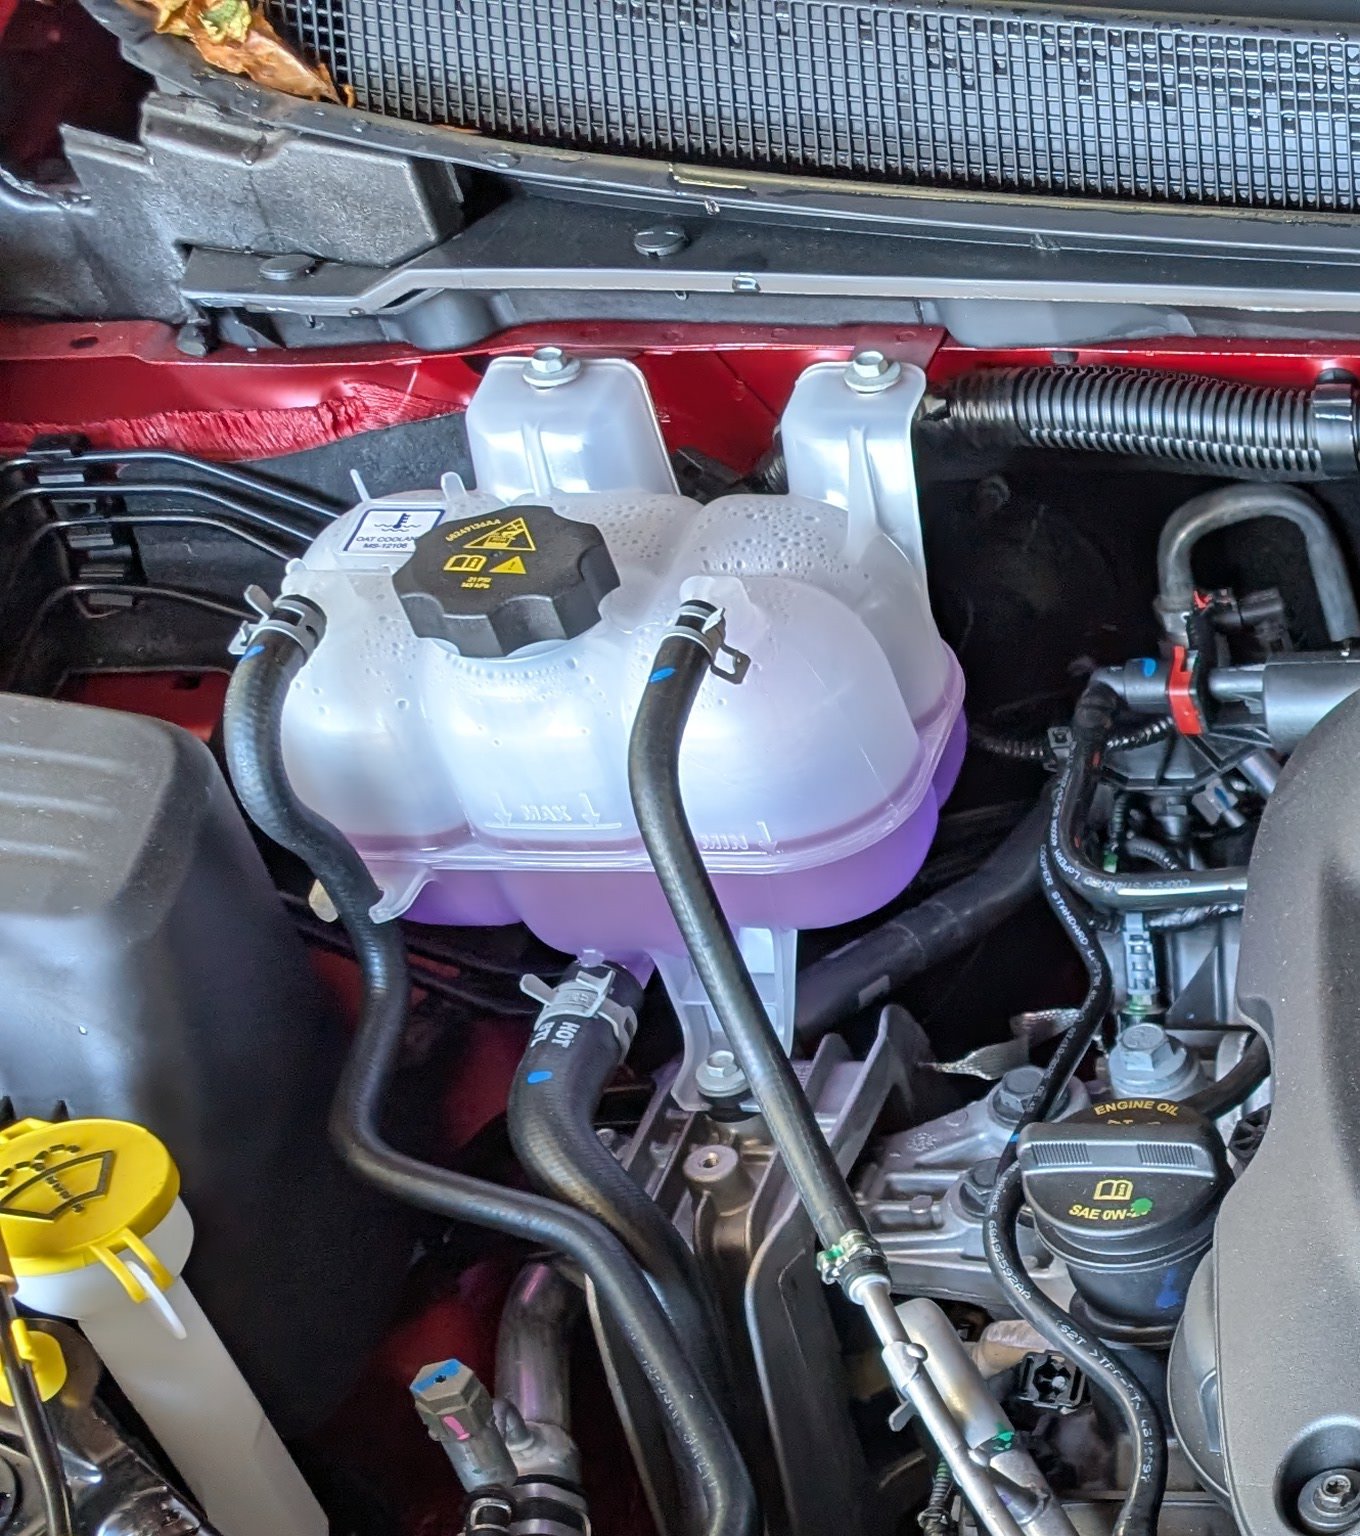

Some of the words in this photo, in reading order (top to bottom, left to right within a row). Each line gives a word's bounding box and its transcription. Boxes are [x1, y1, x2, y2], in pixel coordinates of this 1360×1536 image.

[1039, 844, 1053, 886] COOPER
[1051, 890, 1089, 946] STANDARD
[551, 1021, 581, 1048] HOT
[1094, 1099, 1155, 1116] ENGINE
[1156, 1102, 1180, 1117] OIL
[1068, 1204, 1101, 1221] SAE
[1102, 1206, 1149, 1221] 0W-
